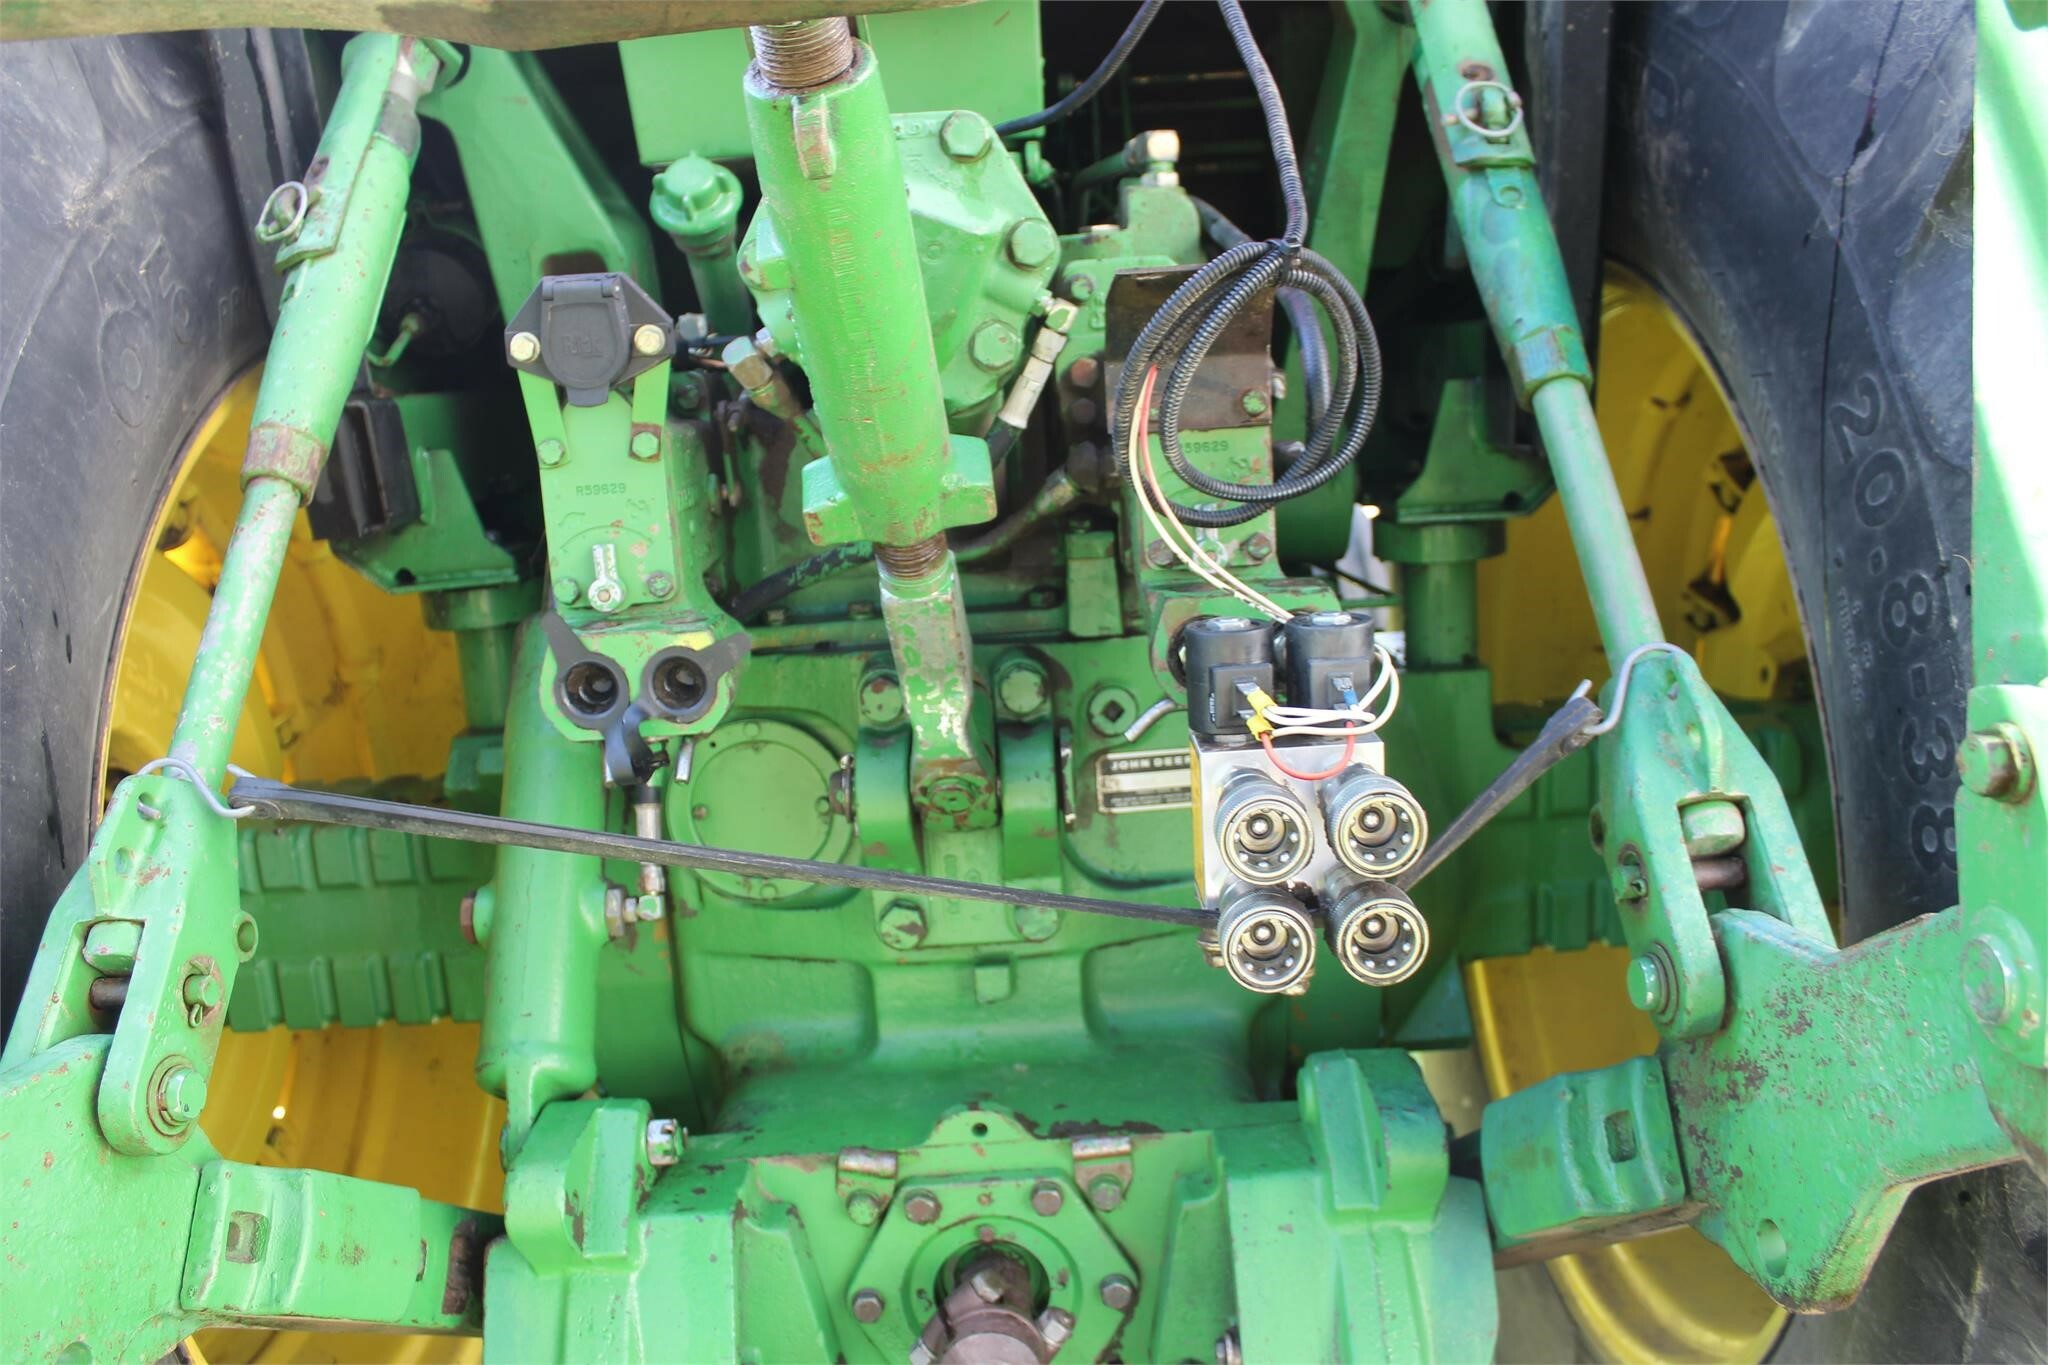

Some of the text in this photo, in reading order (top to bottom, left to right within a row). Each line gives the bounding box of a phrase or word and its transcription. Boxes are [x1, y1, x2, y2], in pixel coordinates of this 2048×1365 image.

[1180, 440, 1229, 453] 59629
[575, 482, 626, 496] R59629
[1111, 758, 1151, 771] JOHN
